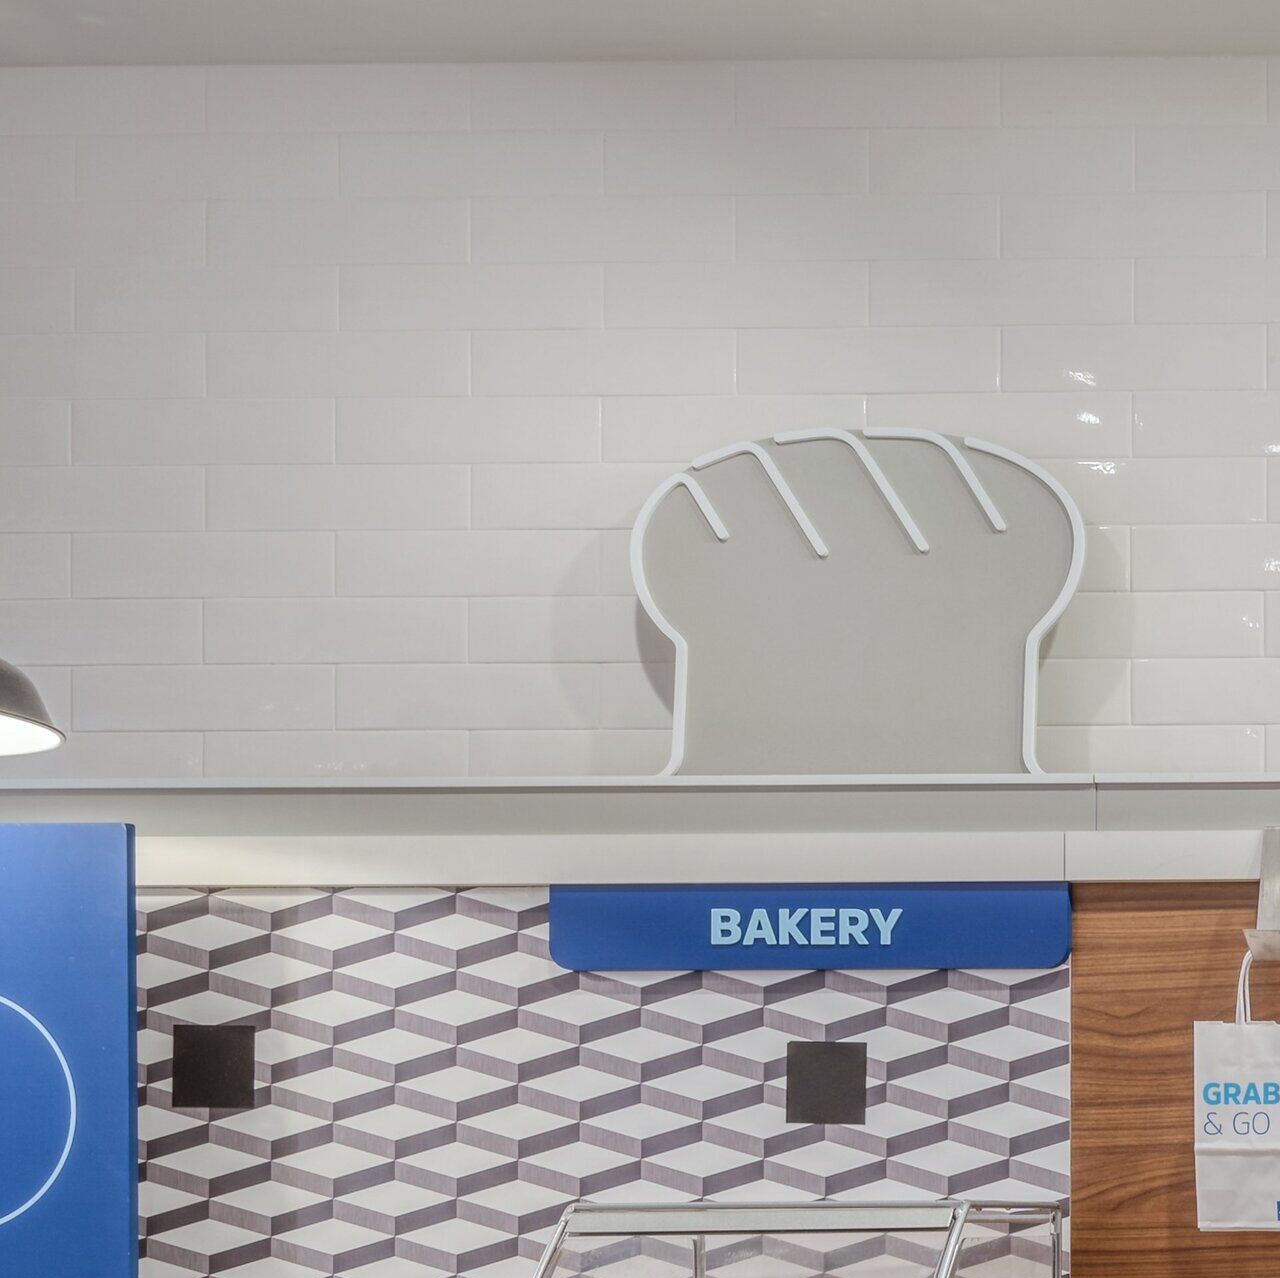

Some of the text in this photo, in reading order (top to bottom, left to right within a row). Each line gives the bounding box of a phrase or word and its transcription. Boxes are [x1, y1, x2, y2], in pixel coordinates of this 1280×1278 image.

[710, 908, 903, 946] BAKERY
[1202, 1082, 1280, 1106] GRAB
[1203, 1112, 1271, 1136] & GO
